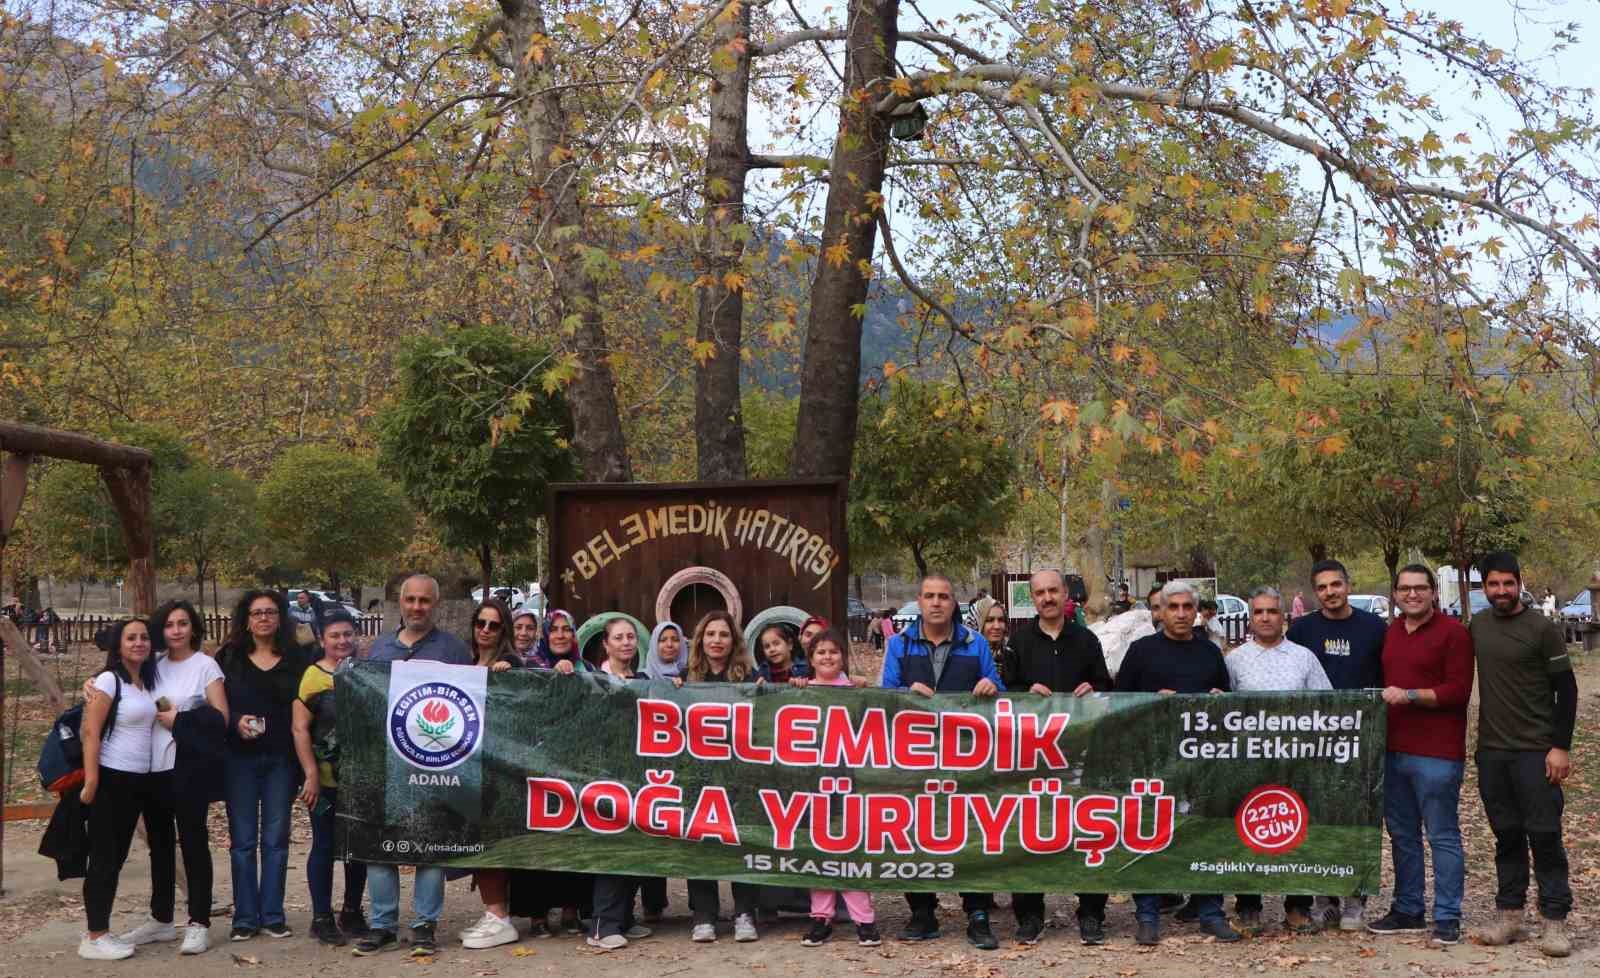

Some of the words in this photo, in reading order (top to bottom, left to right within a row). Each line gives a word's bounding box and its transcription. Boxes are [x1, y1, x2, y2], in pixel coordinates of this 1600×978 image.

[1180, 711, 1217, 732] 13.
[1223, 709, 1362, 732] Geleneksel
[636, 698, 1070, 771] BELEMEDİK
[1179, 737, 1238, 759] Gezi
[1246, 736, 1359, 763] Etkinliği
[408, 773, 461, 787] ADANA
[527, 769, 741, 846] DOĞA
[758, 776, 1175, 867] YÜRÜYÜŞÜ
[1247, 802, 1295, 823] 2278.
[1254, 819, 1295, 840] GÜN
[743, 854, 772, 871] 15
[780, 857, 872, 879] KASIM
[879, 862, 954, 879] 2023
[1190, 861, 1354, 878] #SağlıklıYaşamYürüyüşü
